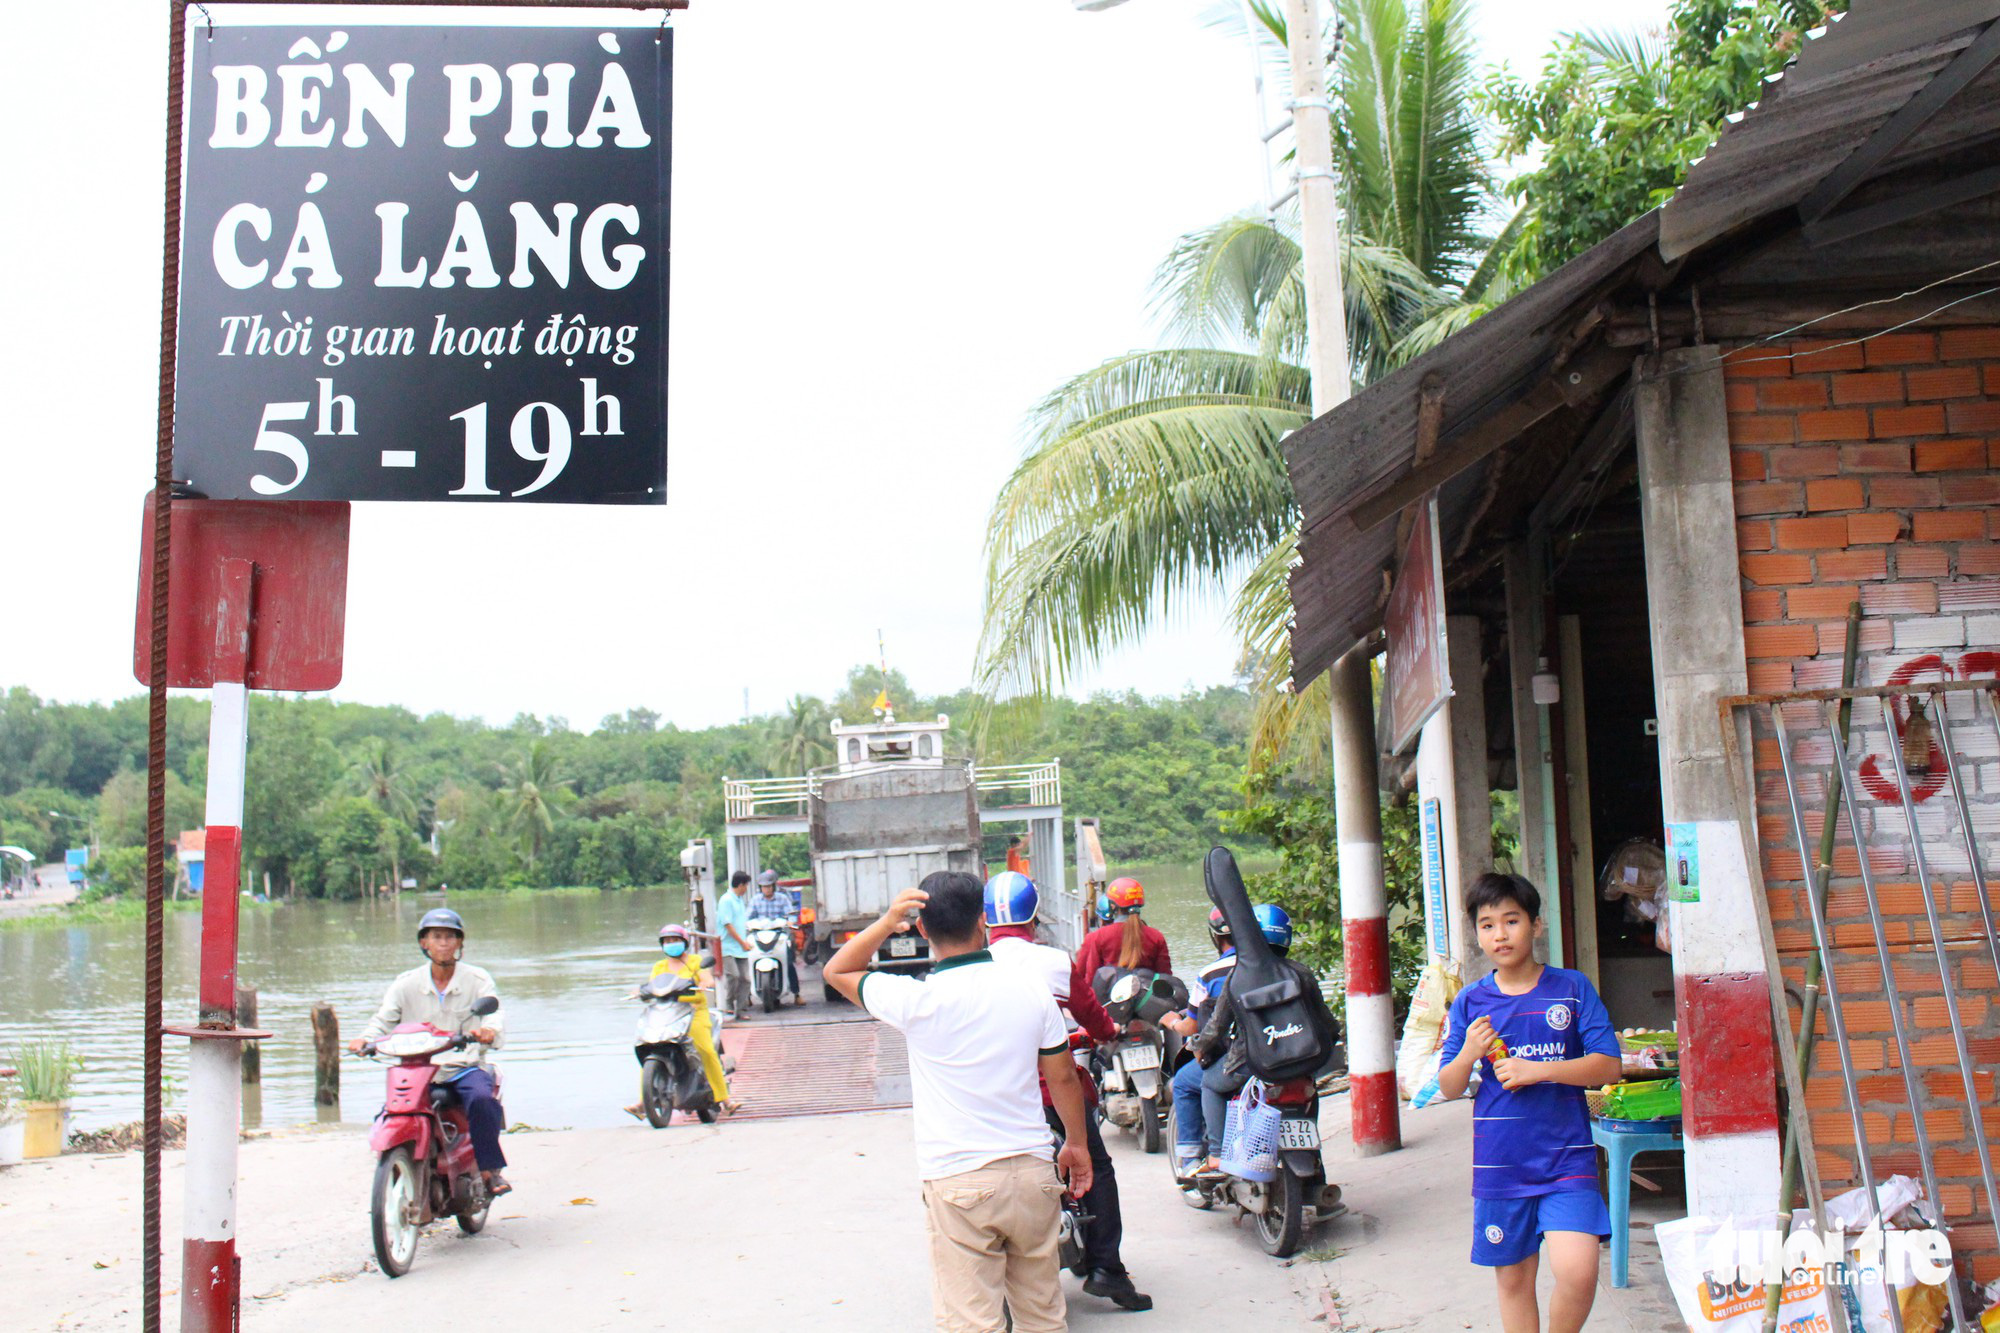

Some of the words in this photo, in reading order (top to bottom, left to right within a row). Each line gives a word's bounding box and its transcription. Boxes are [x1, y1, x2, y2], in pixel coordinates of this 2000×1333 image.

[208, 31, 415, 149] BẾN
[443, 32, 652, 149] PHÀ
[212, 172, 343, 290] CÁ
[374, 170, 647, 290] LĂNG
[217, 310, 314, 356] Thời
[429, 313, 526, 370] hoạt
[534, 313, 639, 366] động
[1508, 1042, 1566, 1058] OKOHAM
[1280, 1134, 1313, 1147] 1681
[1786, 1285, 1818, 1300] FEED
